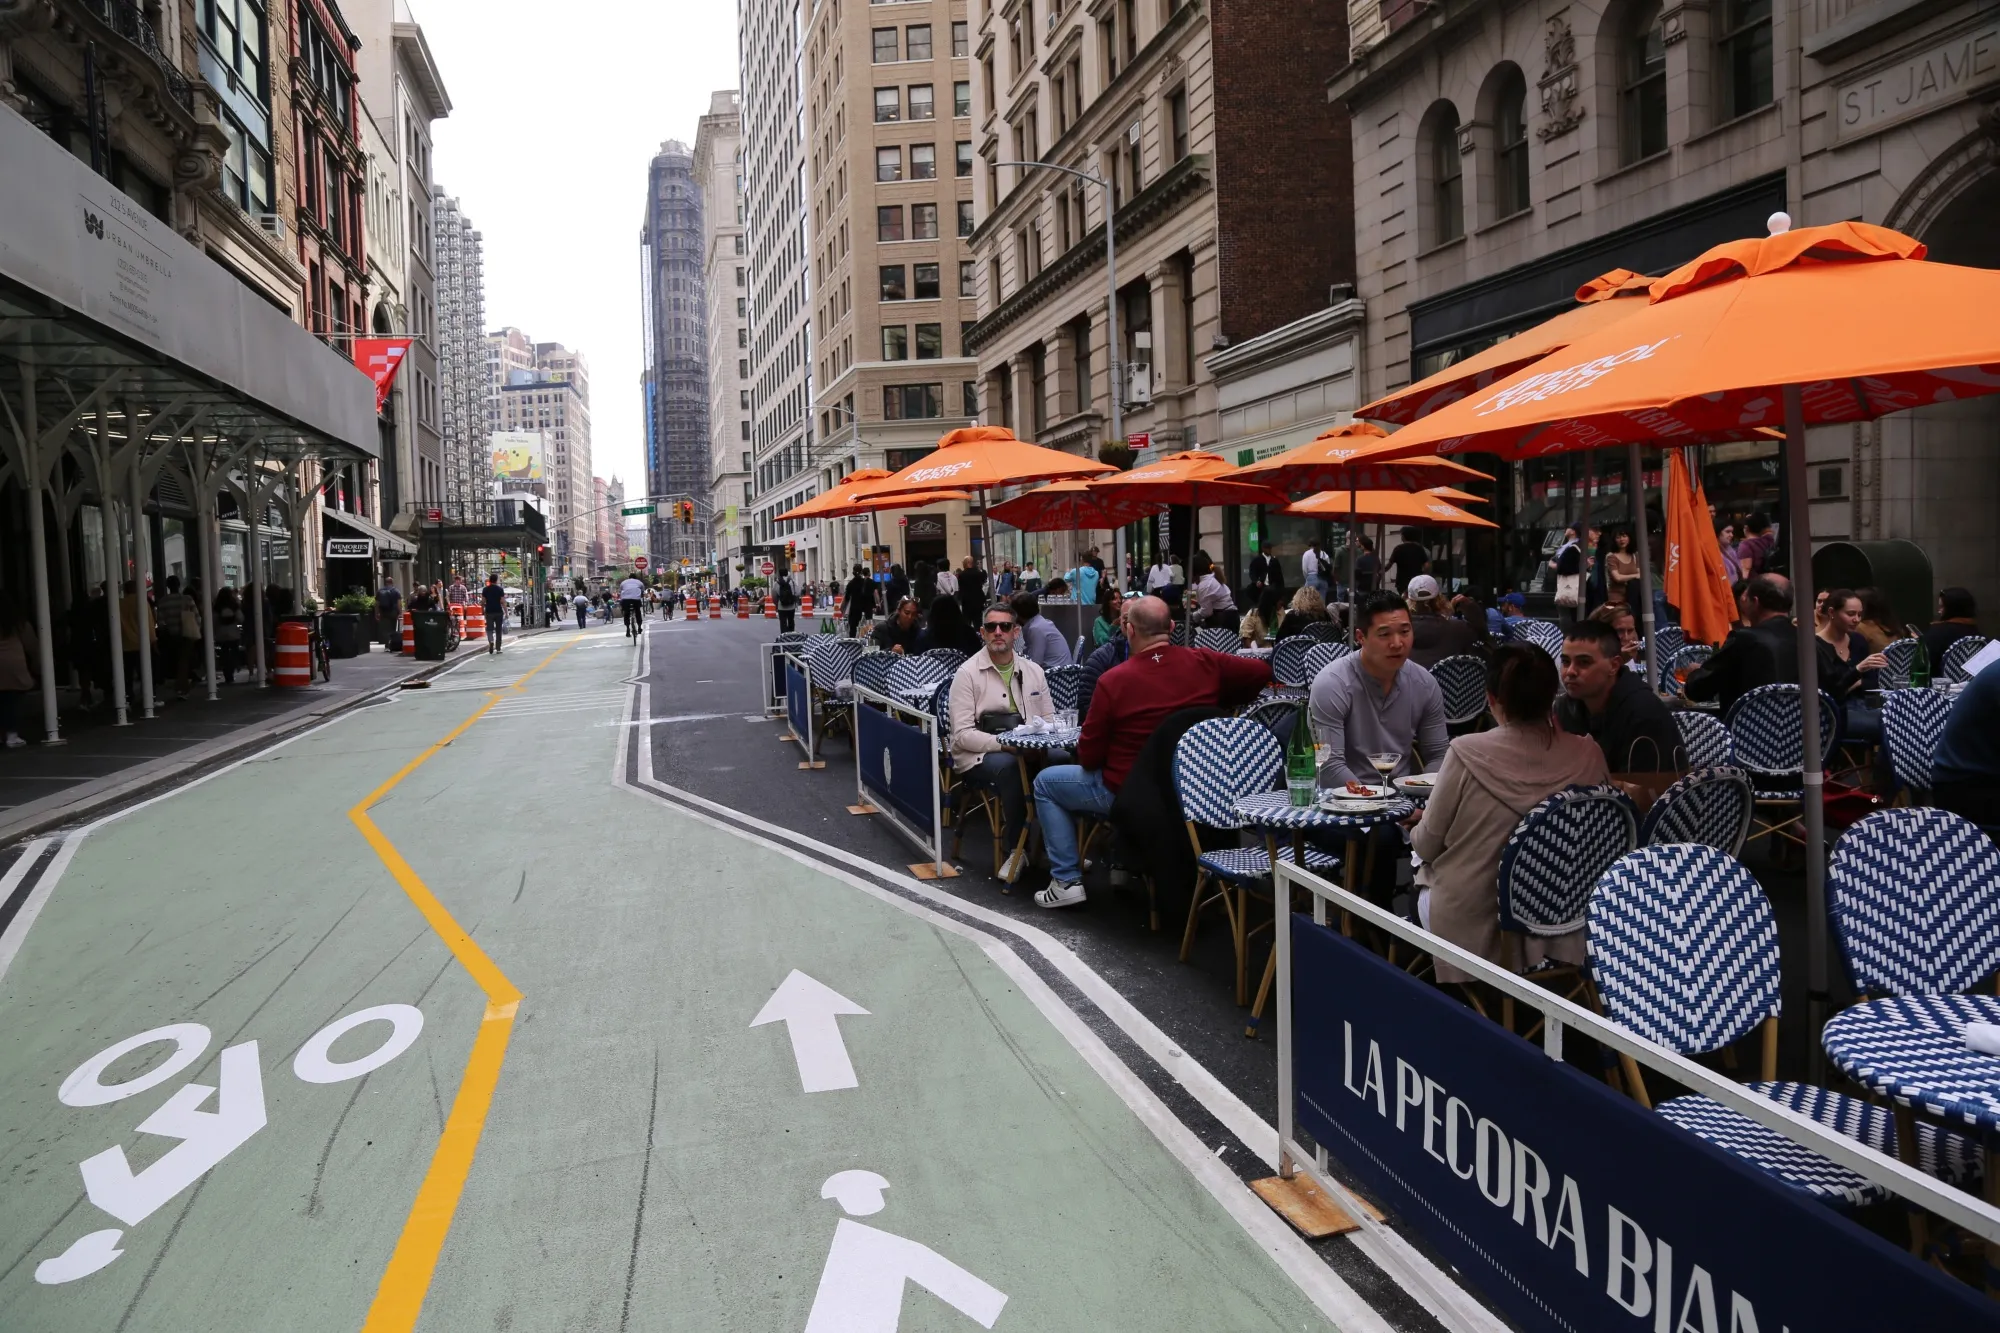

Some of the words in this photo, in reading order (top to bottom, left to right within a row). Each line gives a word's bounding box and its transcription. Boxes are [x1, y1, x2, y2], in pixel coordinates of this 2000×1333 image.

[1844, 79, 1886, 126] ST.
[1895, 30, 1998, 106] JAME
[105, 229, 133, 254] URBAN
[135, 248, 172, 280] UMBRELLA
[1471, 337, 1671, 410] APEROL
[1476, 367, 1616, 417] SPRITZ
[904, 460, 973, 481] APEROL
[910, 469, 960, 484] SPRITZ
[1343, 1019, 1387, 1118] LA
[1395, 1055, 1590, 1279] PECORA
